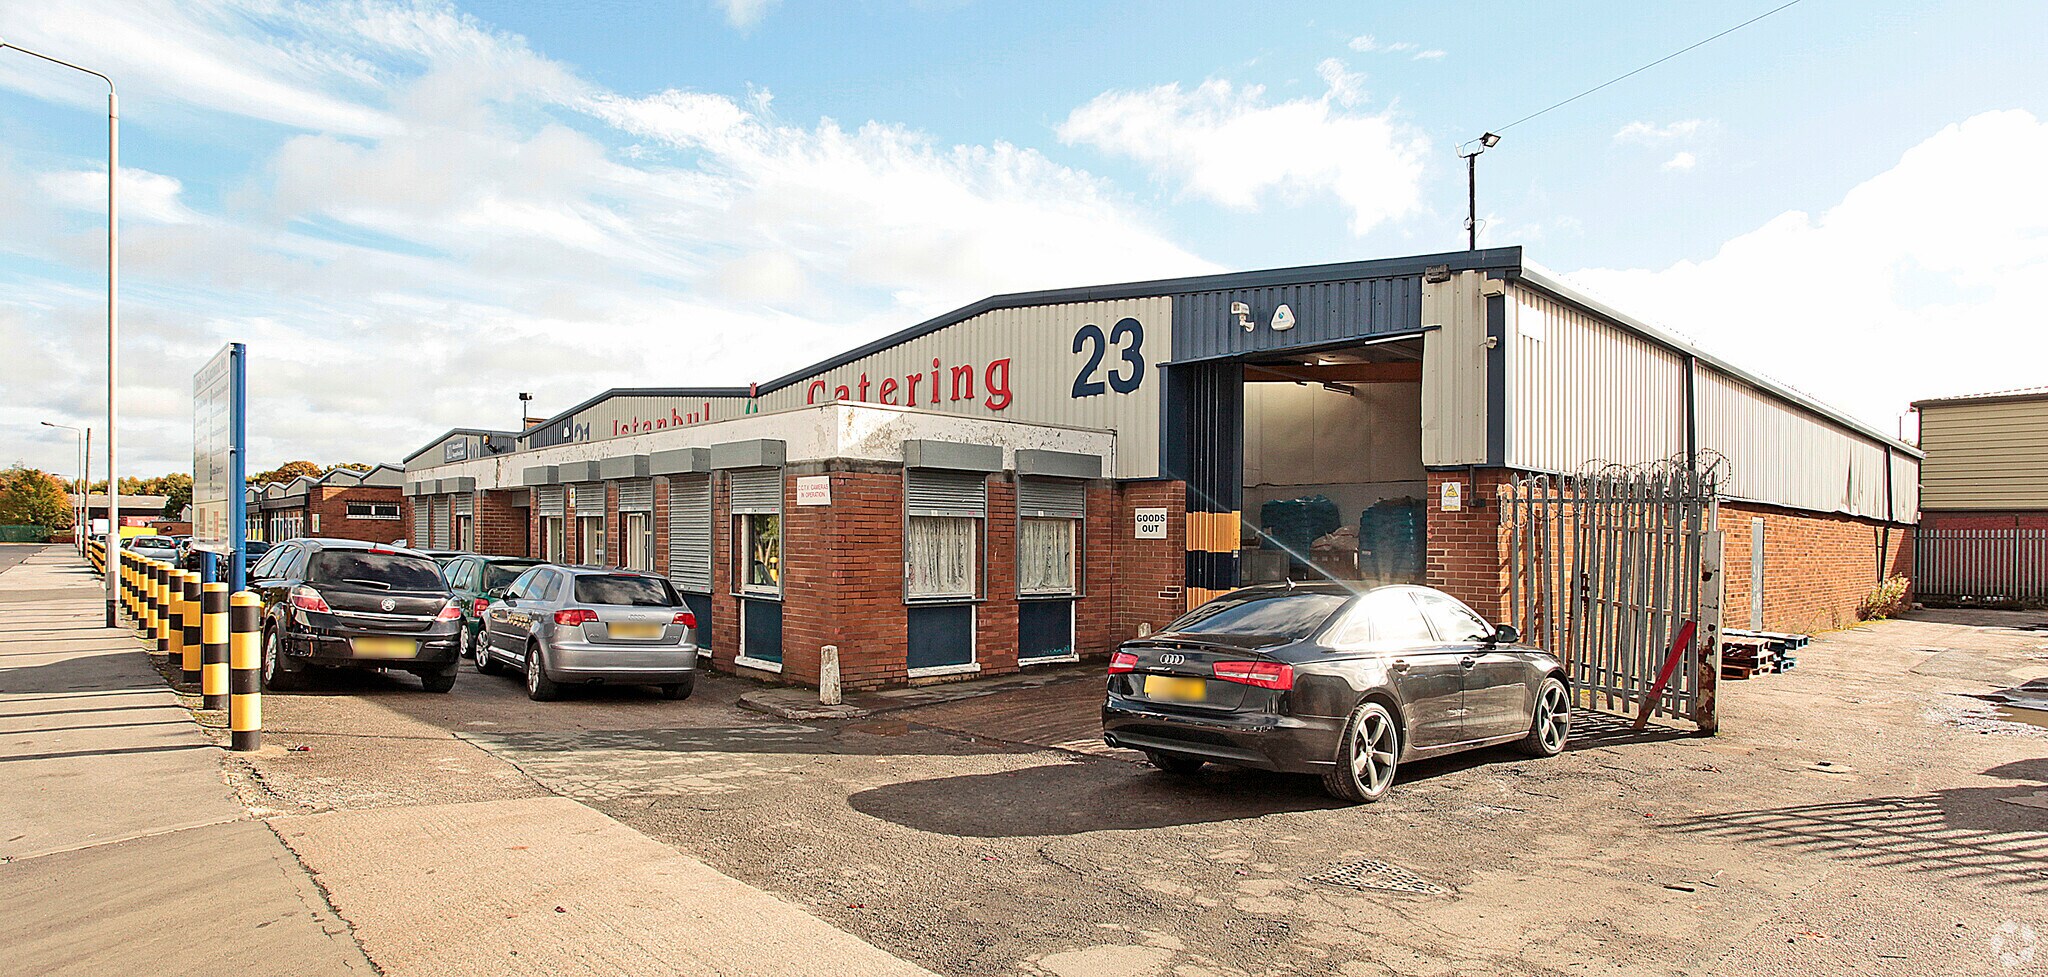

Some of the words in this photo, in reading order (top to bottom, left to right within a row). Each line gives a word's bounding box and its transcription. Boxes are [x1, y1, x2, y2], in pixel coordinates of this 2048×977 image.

[1071, 317, 1145, 399] 23
[807, 358, 1013, 411] Catering
[1136, 514, 1166, 522] GOODS
[1141, 524, 1160, 533] OUT
